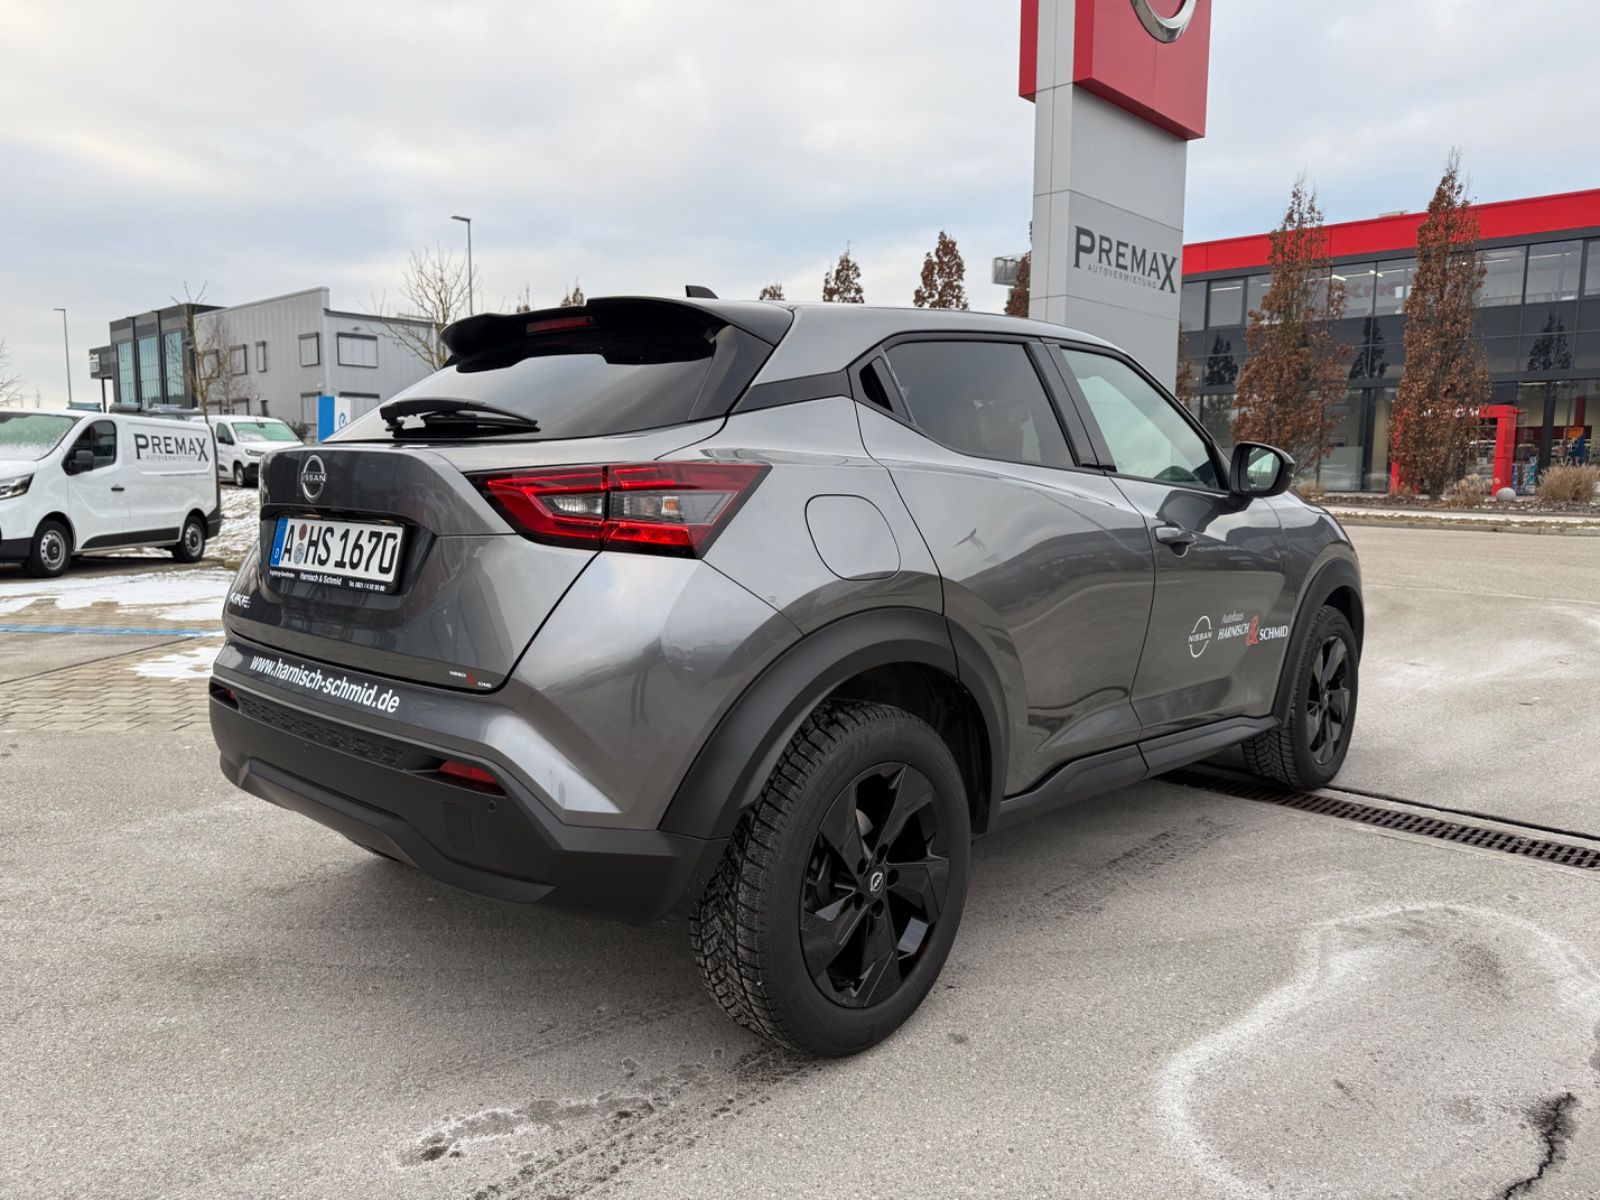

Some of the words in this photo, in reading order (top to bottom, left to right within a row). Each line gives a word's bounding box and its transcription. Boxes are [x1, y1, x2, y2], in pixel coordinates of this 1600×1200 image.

[1073, 225, 1178, 294] PREMAX
[1087, 264, 1157, 290] AUTOVERMIETUNG
[133, 433, 209, 462] PREMAX
[281, 524, 295, 562] A
[1188, 631, 1213, 643] NISSAN
[1259, 625, 1289, 641] SCHMID
[249, 655, 401, 713] www.harnisch-schmid.de
